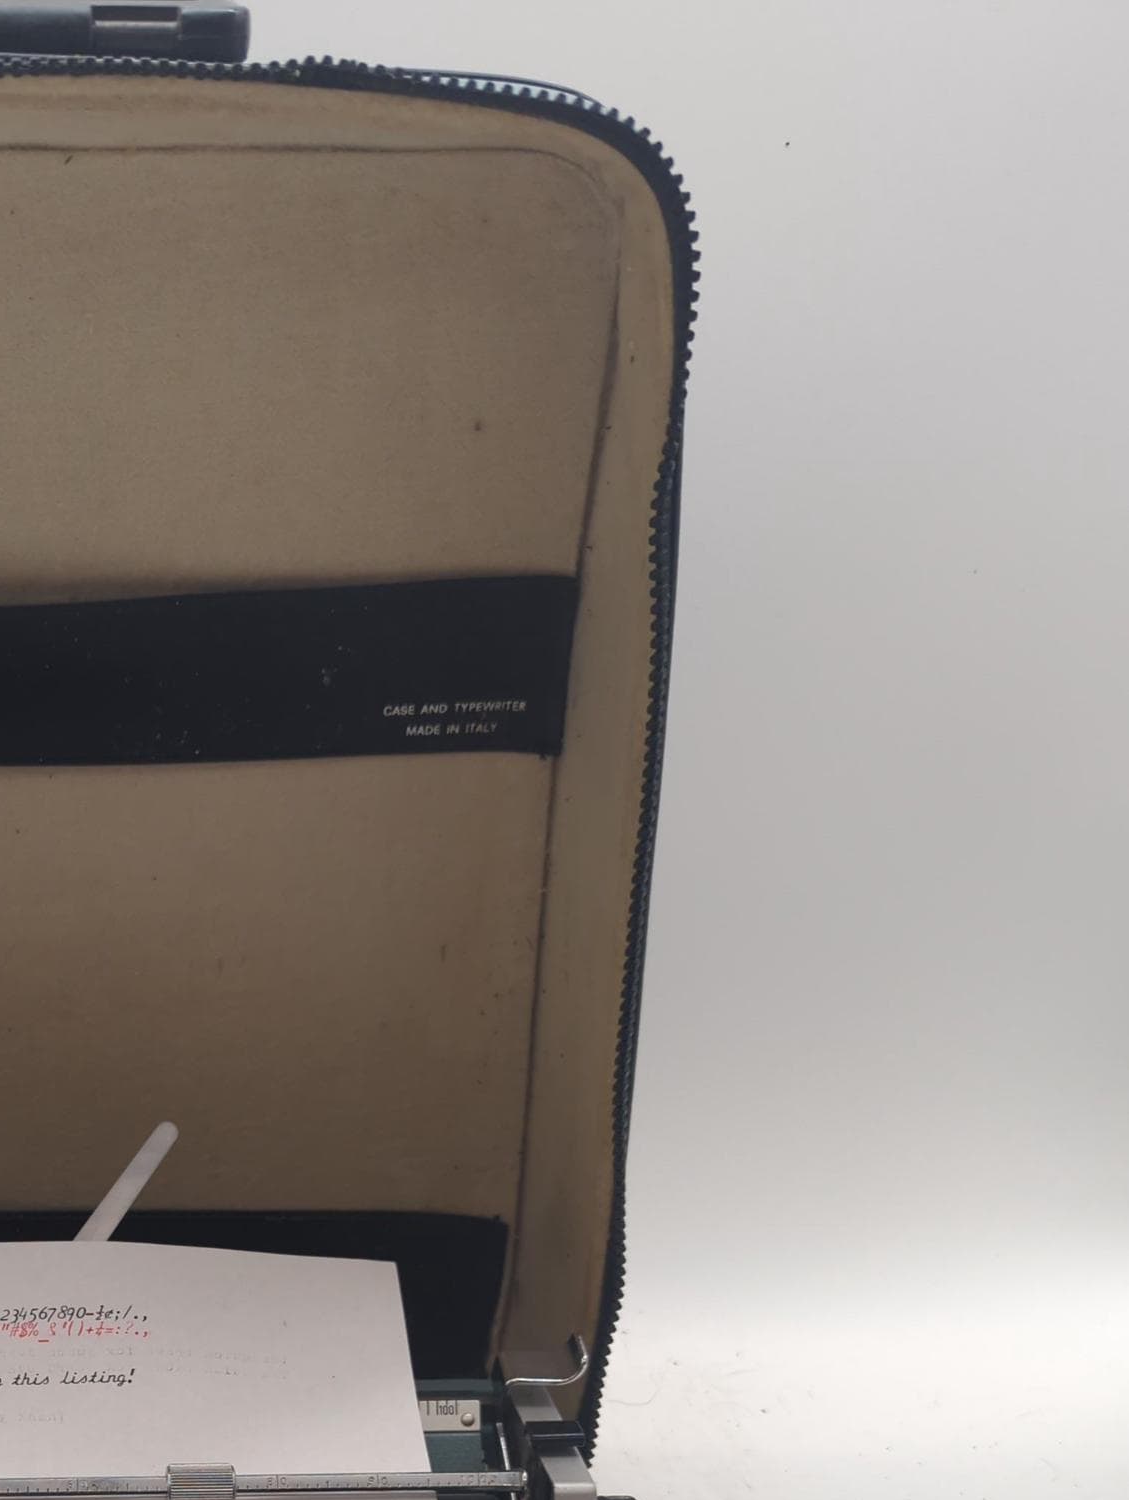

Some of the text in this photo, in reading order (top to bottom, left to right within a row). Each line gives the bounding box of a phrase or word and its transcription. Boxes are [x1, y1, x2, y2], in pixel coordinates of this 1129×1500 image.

[383, 700, 527, 717] CASE AND TYPEWRITER
[405, 722, 498, 737] MADE IN ITALY
[11, 1371, 50, 1387] this
[60, 1367, 136, 1388] listing!
